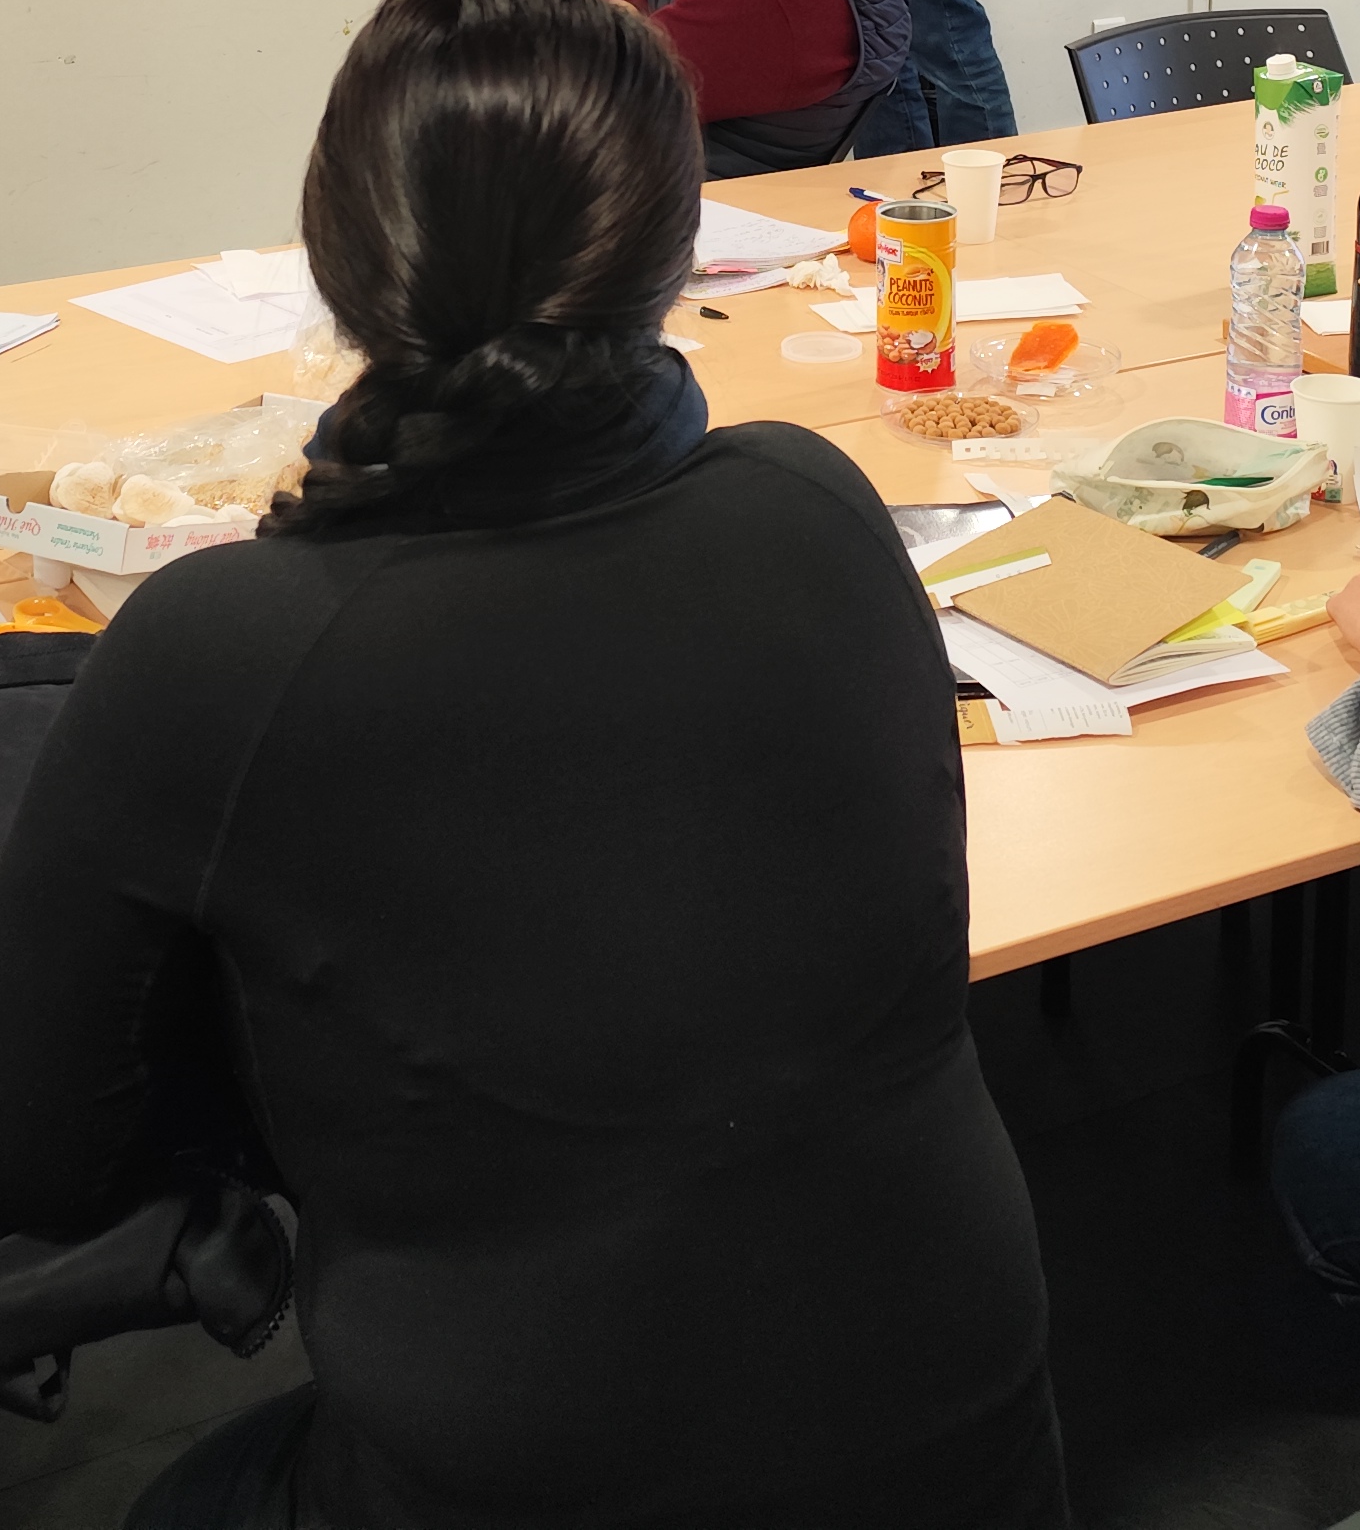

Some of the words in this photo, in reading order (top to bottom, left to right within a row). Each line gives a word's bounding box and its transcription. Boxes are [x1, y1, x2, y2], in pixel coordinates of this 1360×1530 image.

[1254, 143, 1268, 156] AU
[1273, 145, 1289, 159] DE
[1254, 158, 1285, 172] COCO
[889, 276, 934, 293] PEANUTS
[887, 291, 935, 307] COCONUT
[1260, 404, 1296, 425] Cont
